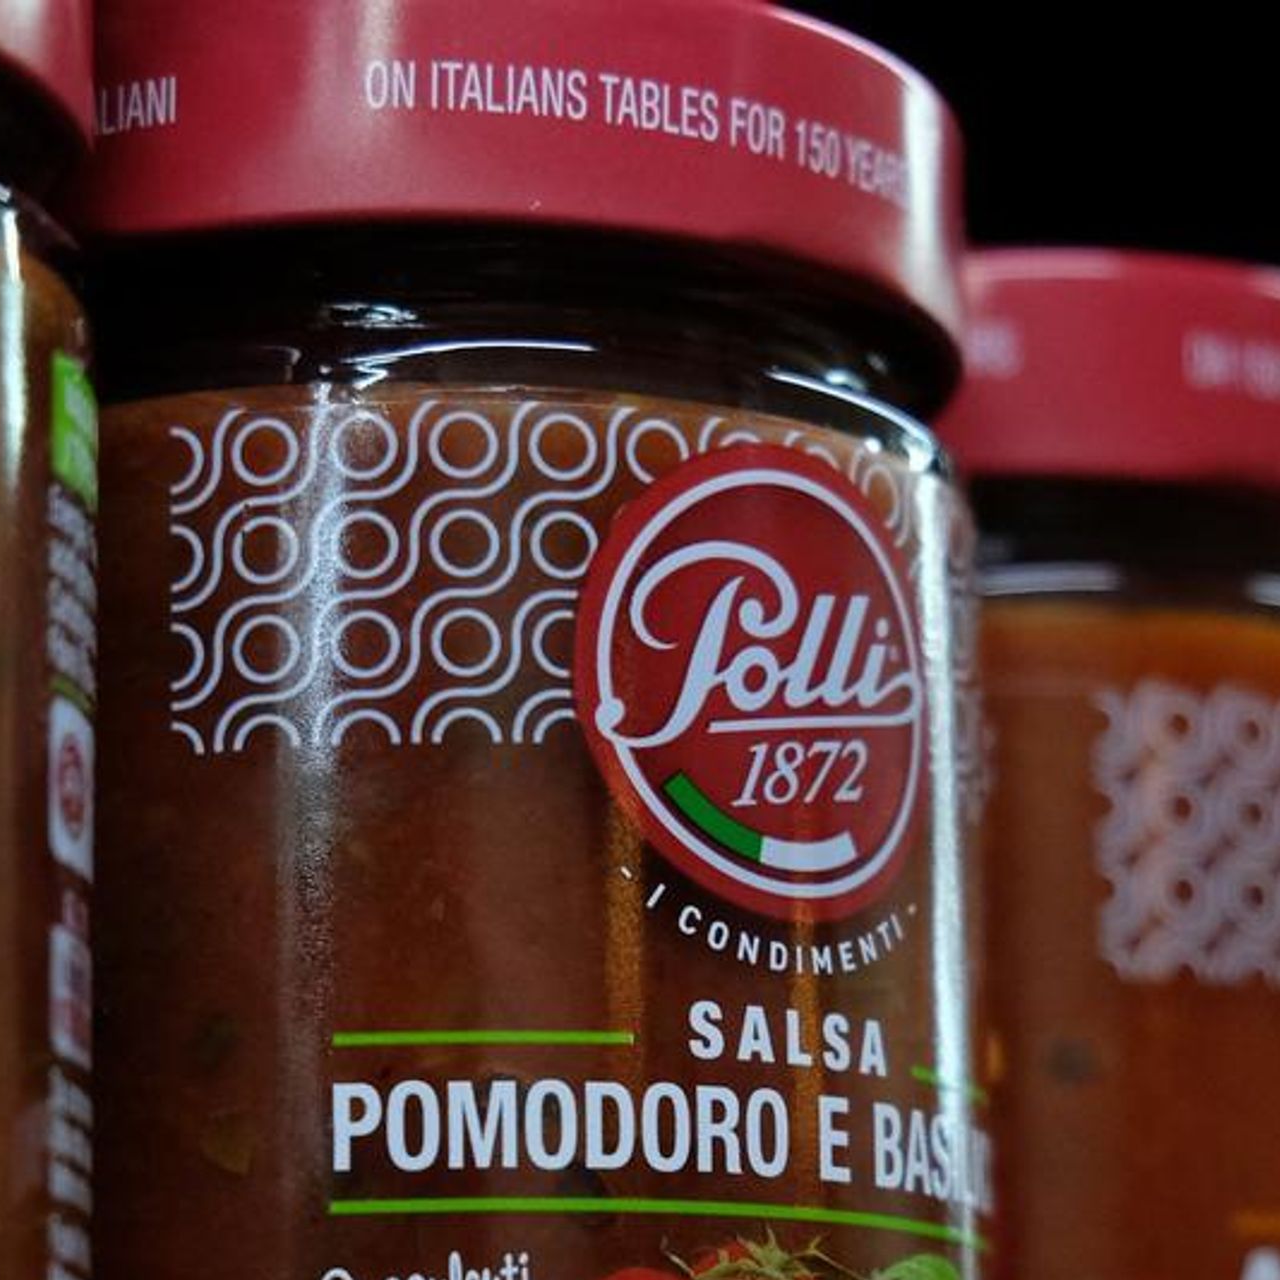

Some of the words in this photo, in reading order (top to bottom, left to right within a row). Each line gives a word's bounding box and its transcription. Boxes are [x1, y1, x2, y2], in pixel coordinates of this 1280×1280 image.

[365, 60, 416, 109] ON
[431, 61, 587, 121] ITALIANS
[599, 74, 719, 143] TABLES
[730, 98, 785, 162] FOR
[796, 118, 841, 179] 150
[629, 540, 920, 748] Polli
[732, 741, 869, 806] 1872
[678, 905, 904, 976] CONDIMENTI
[688, 1000, 887, 1077] SALSA
[331, 1080, 790, 1179] POMODORO
[817, 1094, 852, 1184] E
